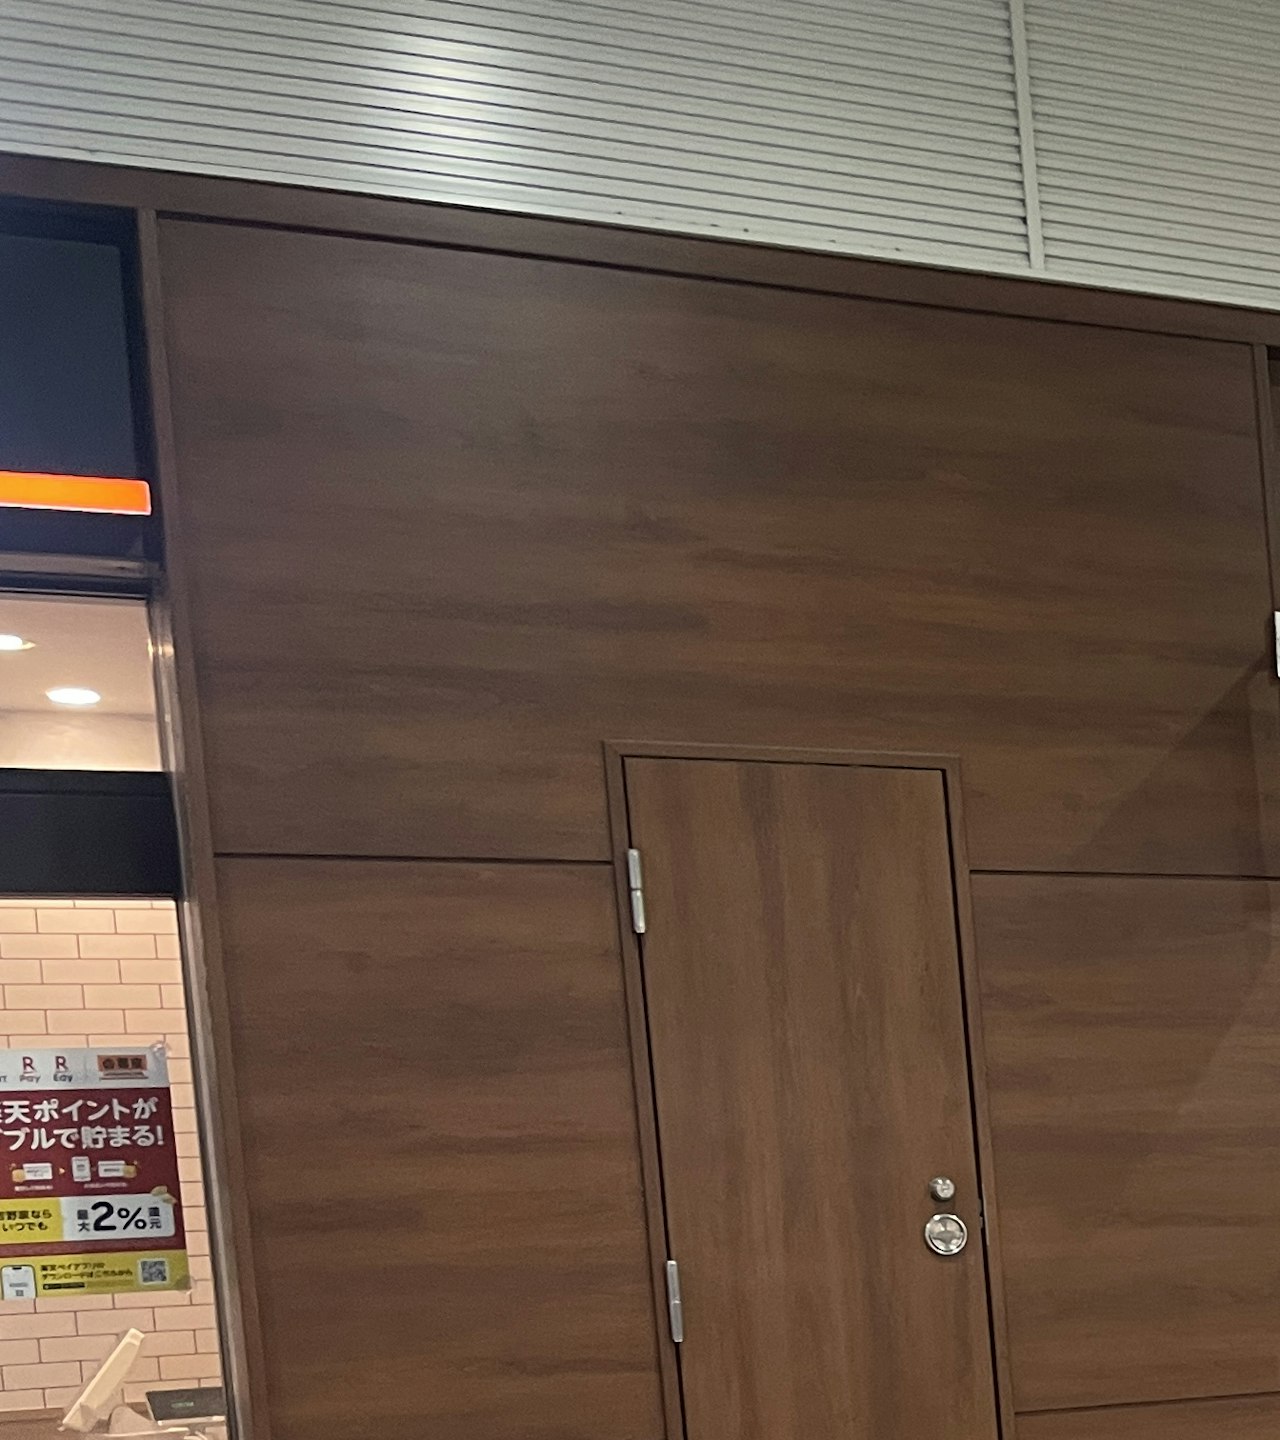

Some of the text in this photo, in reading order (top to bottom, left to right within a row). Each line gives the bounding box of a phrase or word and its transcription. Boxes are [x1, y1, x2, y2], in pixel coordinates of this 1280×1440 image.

[0, 1097, 159, 1125] 天ポイントが
[0, 1125, 164, 1151] ブルで貯まる!
